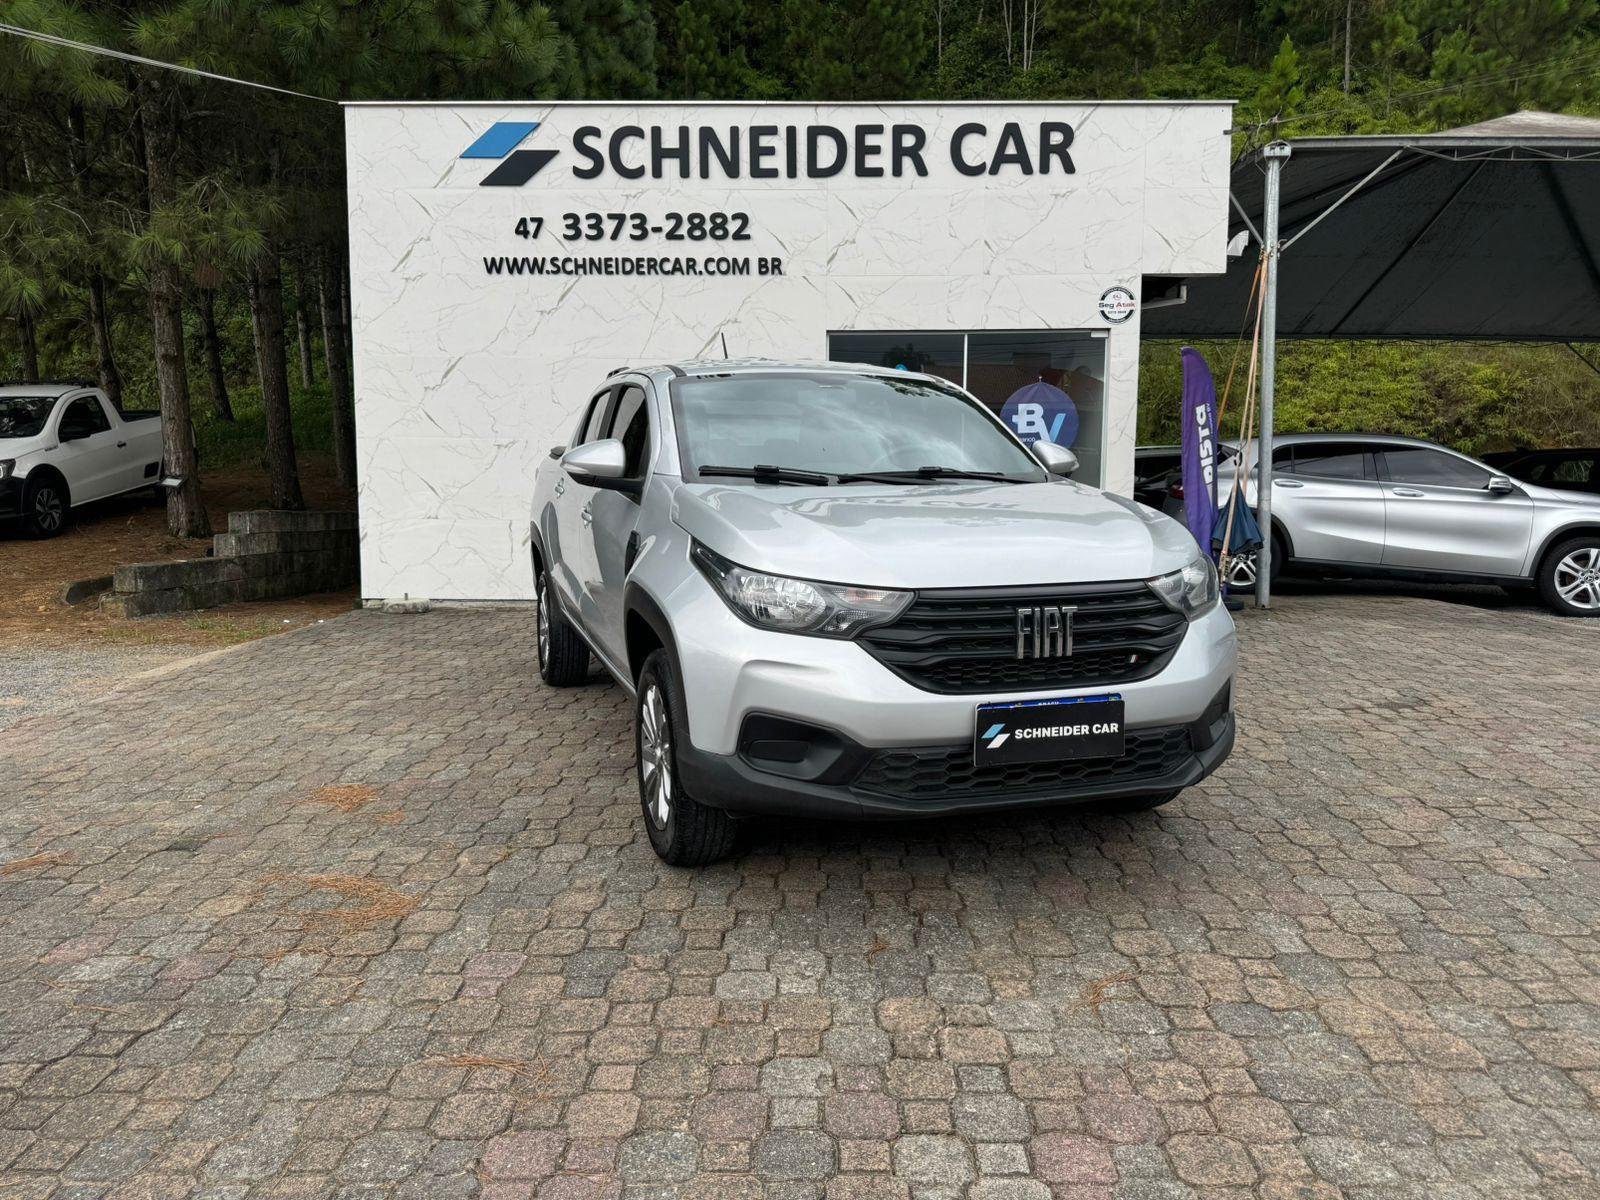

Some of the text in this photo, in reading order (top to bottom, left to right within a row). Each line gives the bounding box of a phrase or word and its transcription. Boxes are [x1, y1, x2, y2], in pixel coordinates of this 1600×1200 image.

[572, 121, 1076, 180] SCHNEIDER CAR
[514, 212, 752, 241] 47 3373-2882
[482, 256, 783, 277] WWW.SCHNEIDERCAR.COM BR
[1012, 403, 1066, 443] BV
[1016, 606, 1078, 659] FIAT
[1014, 722, 1119, 739] SCHNEIDER CAR
